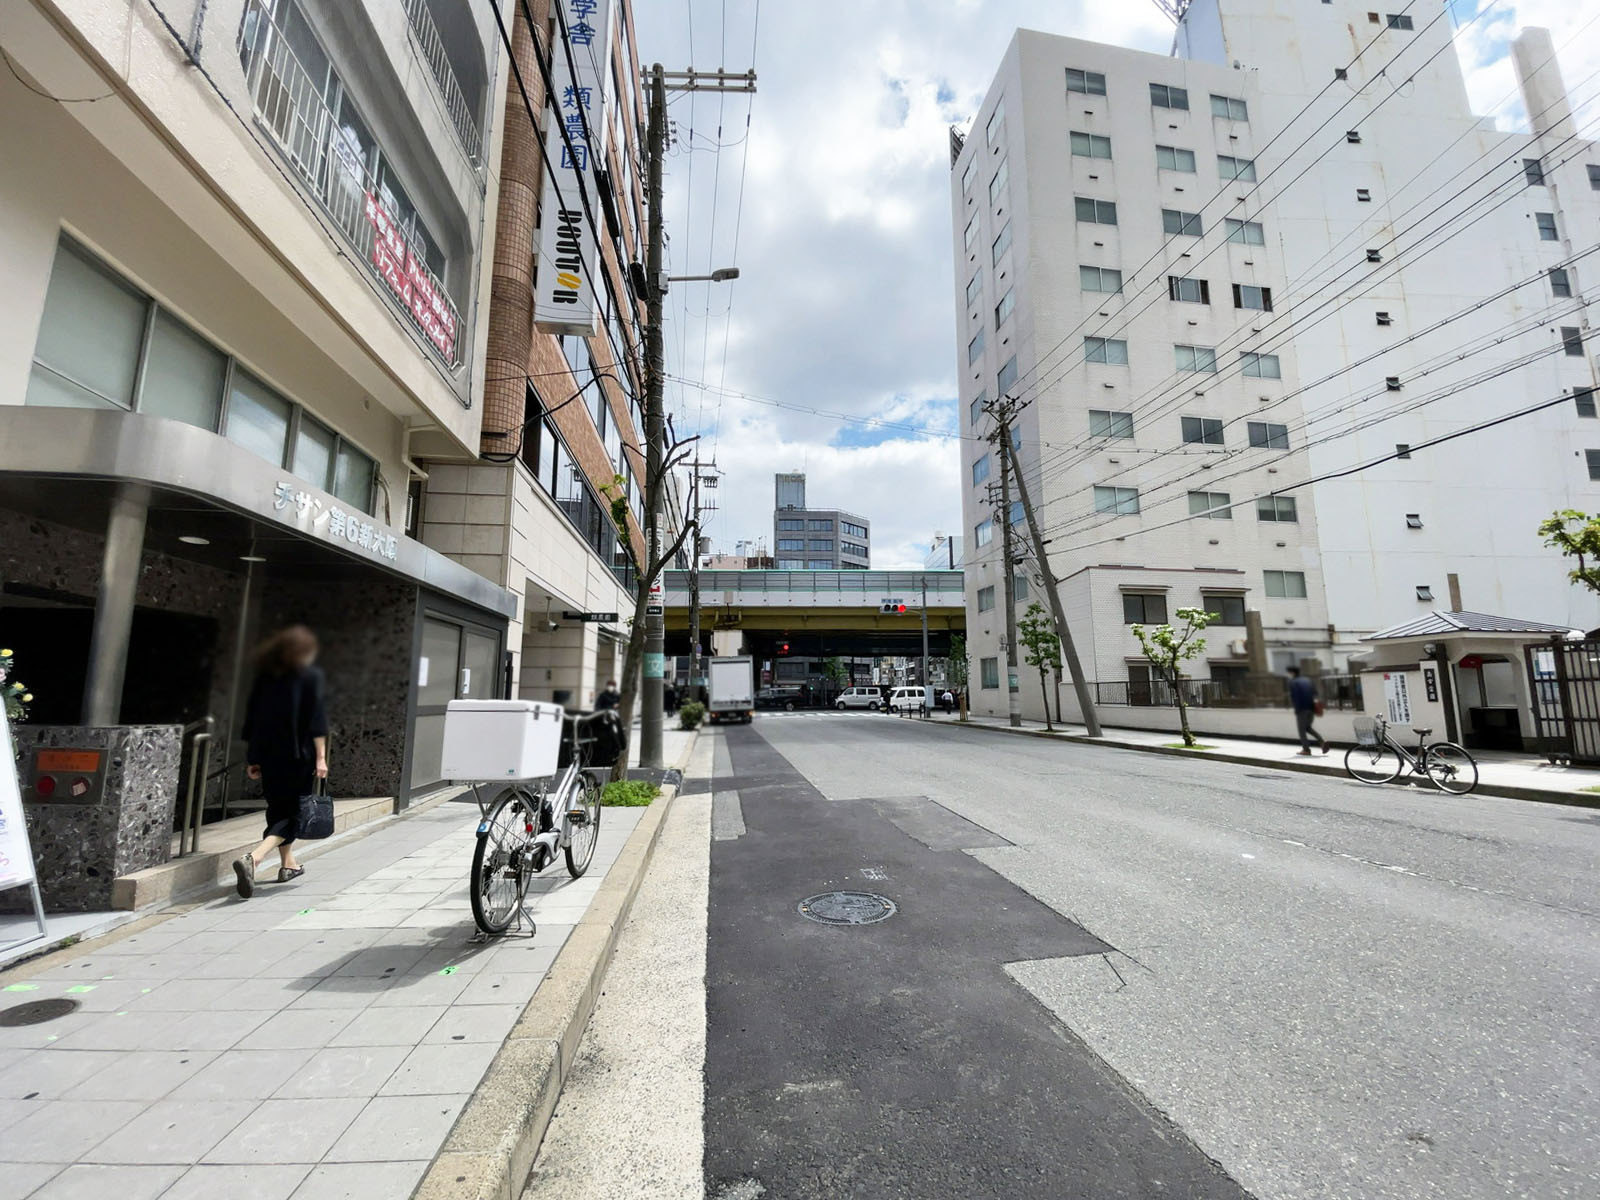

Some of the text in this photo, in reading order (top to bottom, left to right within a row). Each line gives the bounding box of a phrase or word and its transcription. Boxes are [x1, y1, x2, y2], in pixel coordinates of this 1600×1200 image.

[560, 85, 593, 171] 類農園
[552, 209, 582, 304] DOUTOR
